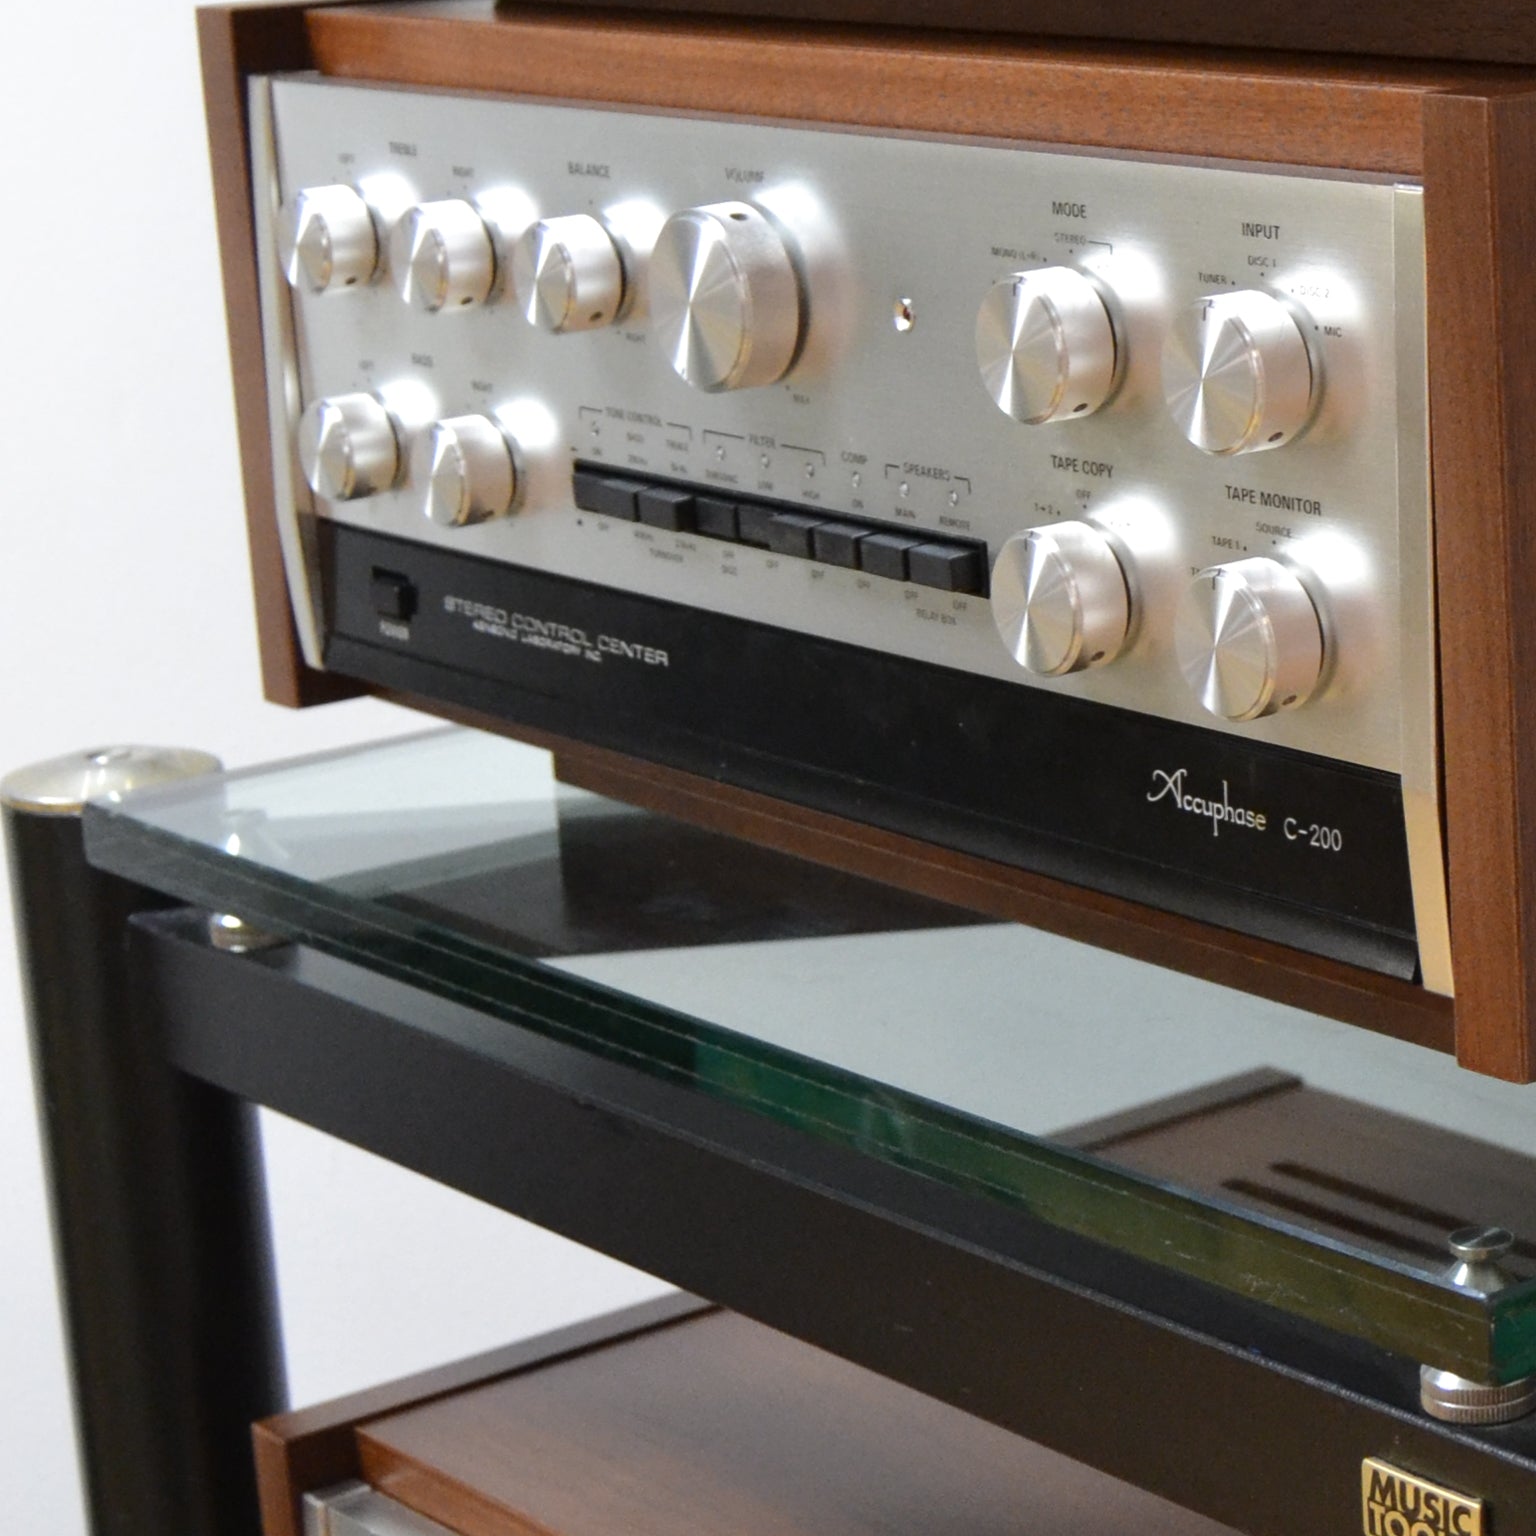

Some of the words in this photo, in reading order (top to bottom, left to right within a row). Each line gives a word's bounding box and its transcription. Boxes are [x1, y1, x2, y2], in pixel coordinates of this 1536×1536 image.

[567, 161, 611, 179] BALANCE
[1052, 201, 1087, 219] MODE
[1054, 232, 1087, 245] STEREO
[1241, 222, 1280, 240] INPUT
[1247, 255, 1269, 268] DISC
[1198, 271, 1227, 285] TUNER
[1299, 285, 1321, 298] DISC
[1323, 326, 1343, 339] MIC
[748, 432, 777, 449] FILTER
[840, 449, 869, 465] COMP
[902, 462, 951, 482] SPEAKERS
[1050, 454, 1079, 472] TAPE
[1082, 460, 1114, 479] COPY
[1075, 488, 1092, 502] OFF
[1224, 484, 1257, 505] TAPE
[1259, 491, 1322, 517] MONITOR
[1255, 520, 1292, 538] SOURCE
[1211, 535, 1232, 549] TAPE
[444, 595, 508, 625] STEREO
[511, 612, 592, 648] CONTROL
[597, 634, 670, 667] CENTER
[1146, 769, 1267, 837] Accuphase
[1284, 817, 1342, 851] C-200
[1370, 1469, 1471, 1535] MUSIC
